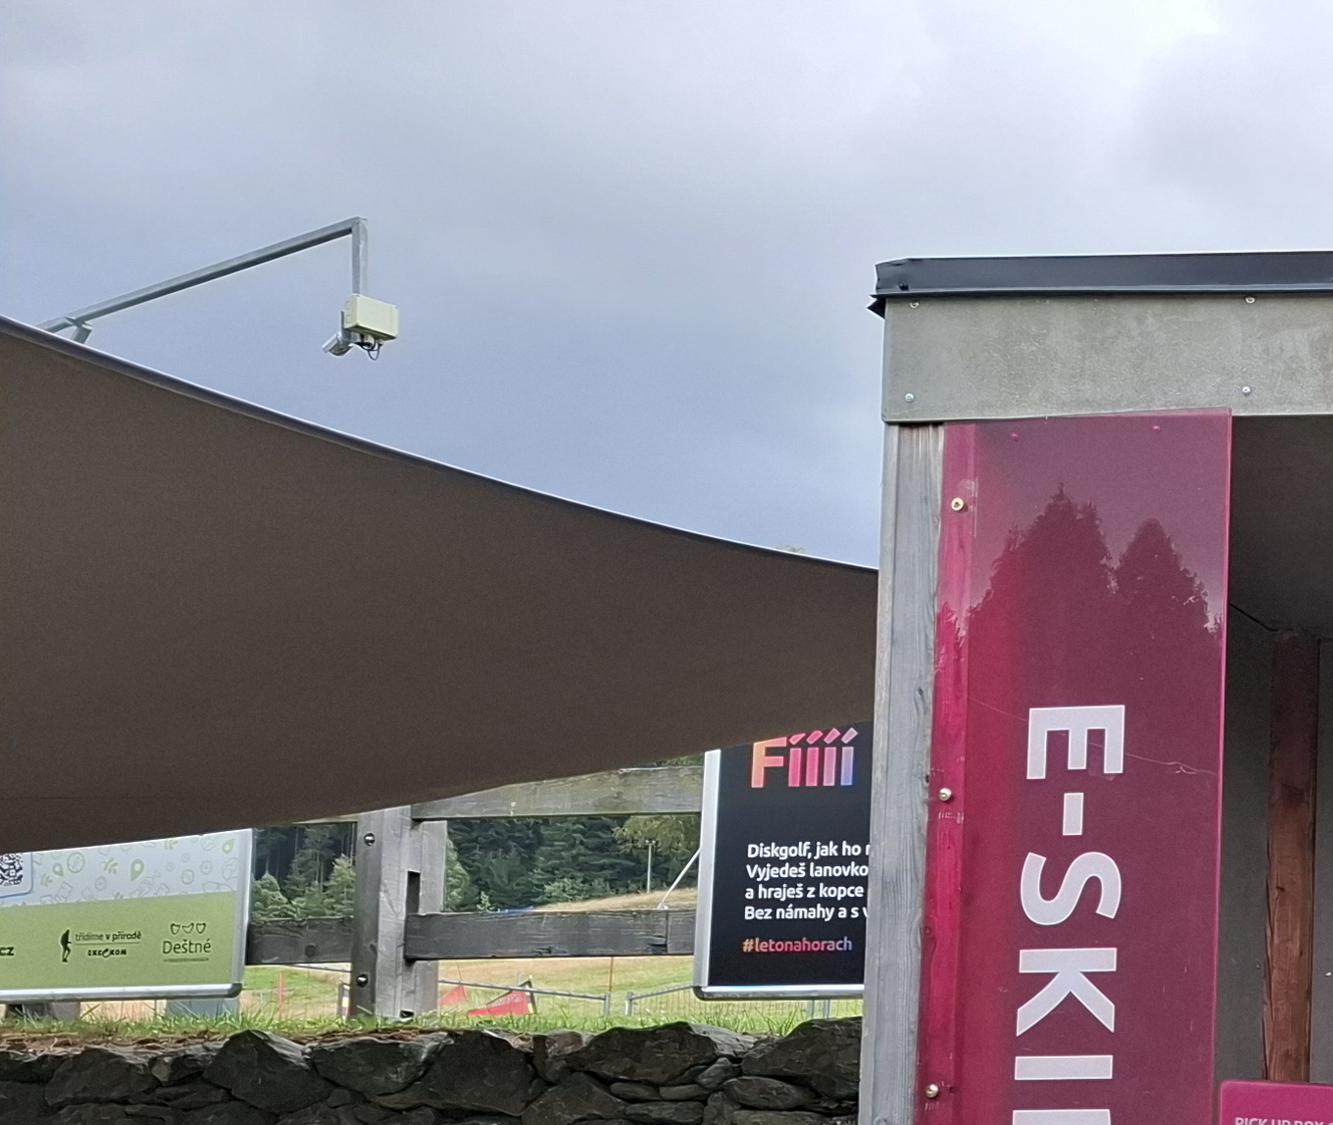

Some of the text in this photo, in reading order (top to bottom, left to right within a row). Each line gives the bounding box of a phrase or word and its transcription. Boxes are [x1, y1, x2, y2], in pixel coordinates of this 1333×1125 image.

[747, 841, 813, 860] Diskgolf,
[813, 840, 839, 859] jak
[841, 840, 862, 856] ho
[746, 862, 806, 881] Vyjedeš
[745, 882, 864, 901] a hraješ z kopce
[744, 905, 772, 920] Bez
[776, 903, 834, 921] námahy
[838, 907, 847, 919] a
[850, 906, 859, 918] s
[162, 938, 212, 955] Deštné
[742, 936, 853, 953] #letonahorach
